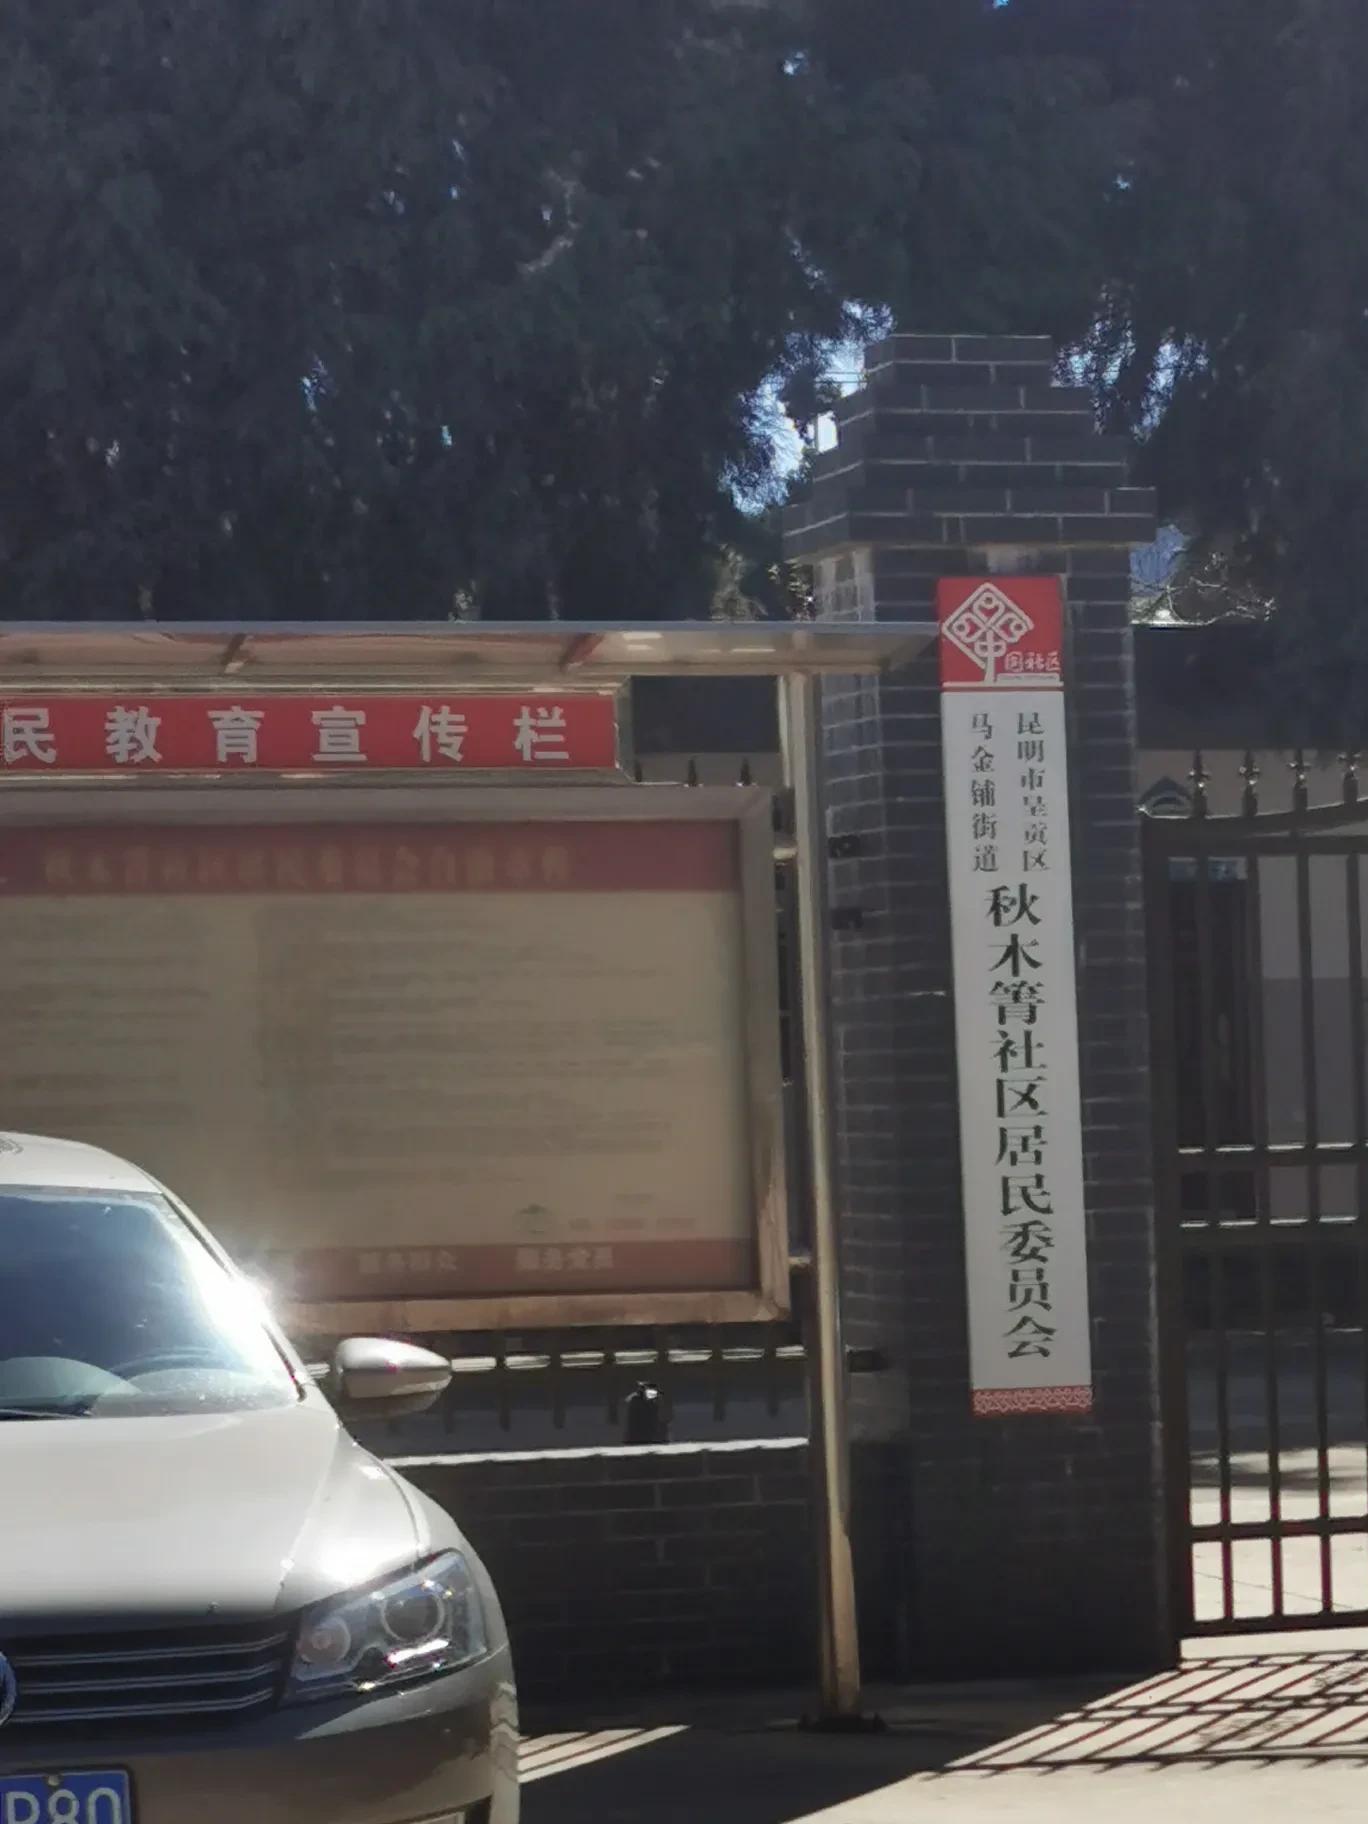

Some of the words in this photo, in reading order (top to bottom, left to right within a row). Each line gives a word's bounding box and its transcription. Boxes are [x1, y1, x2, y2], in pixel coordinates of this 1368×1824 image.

[2, 706, 568, 764] 民教育宣传栏
[970, 712, 999, 873] 马金铺街道
[1017, 712, 1050, 872] 昆明市呈贡区
[985, 883, 1057, 1359] 秋木箐社区居民委员会
